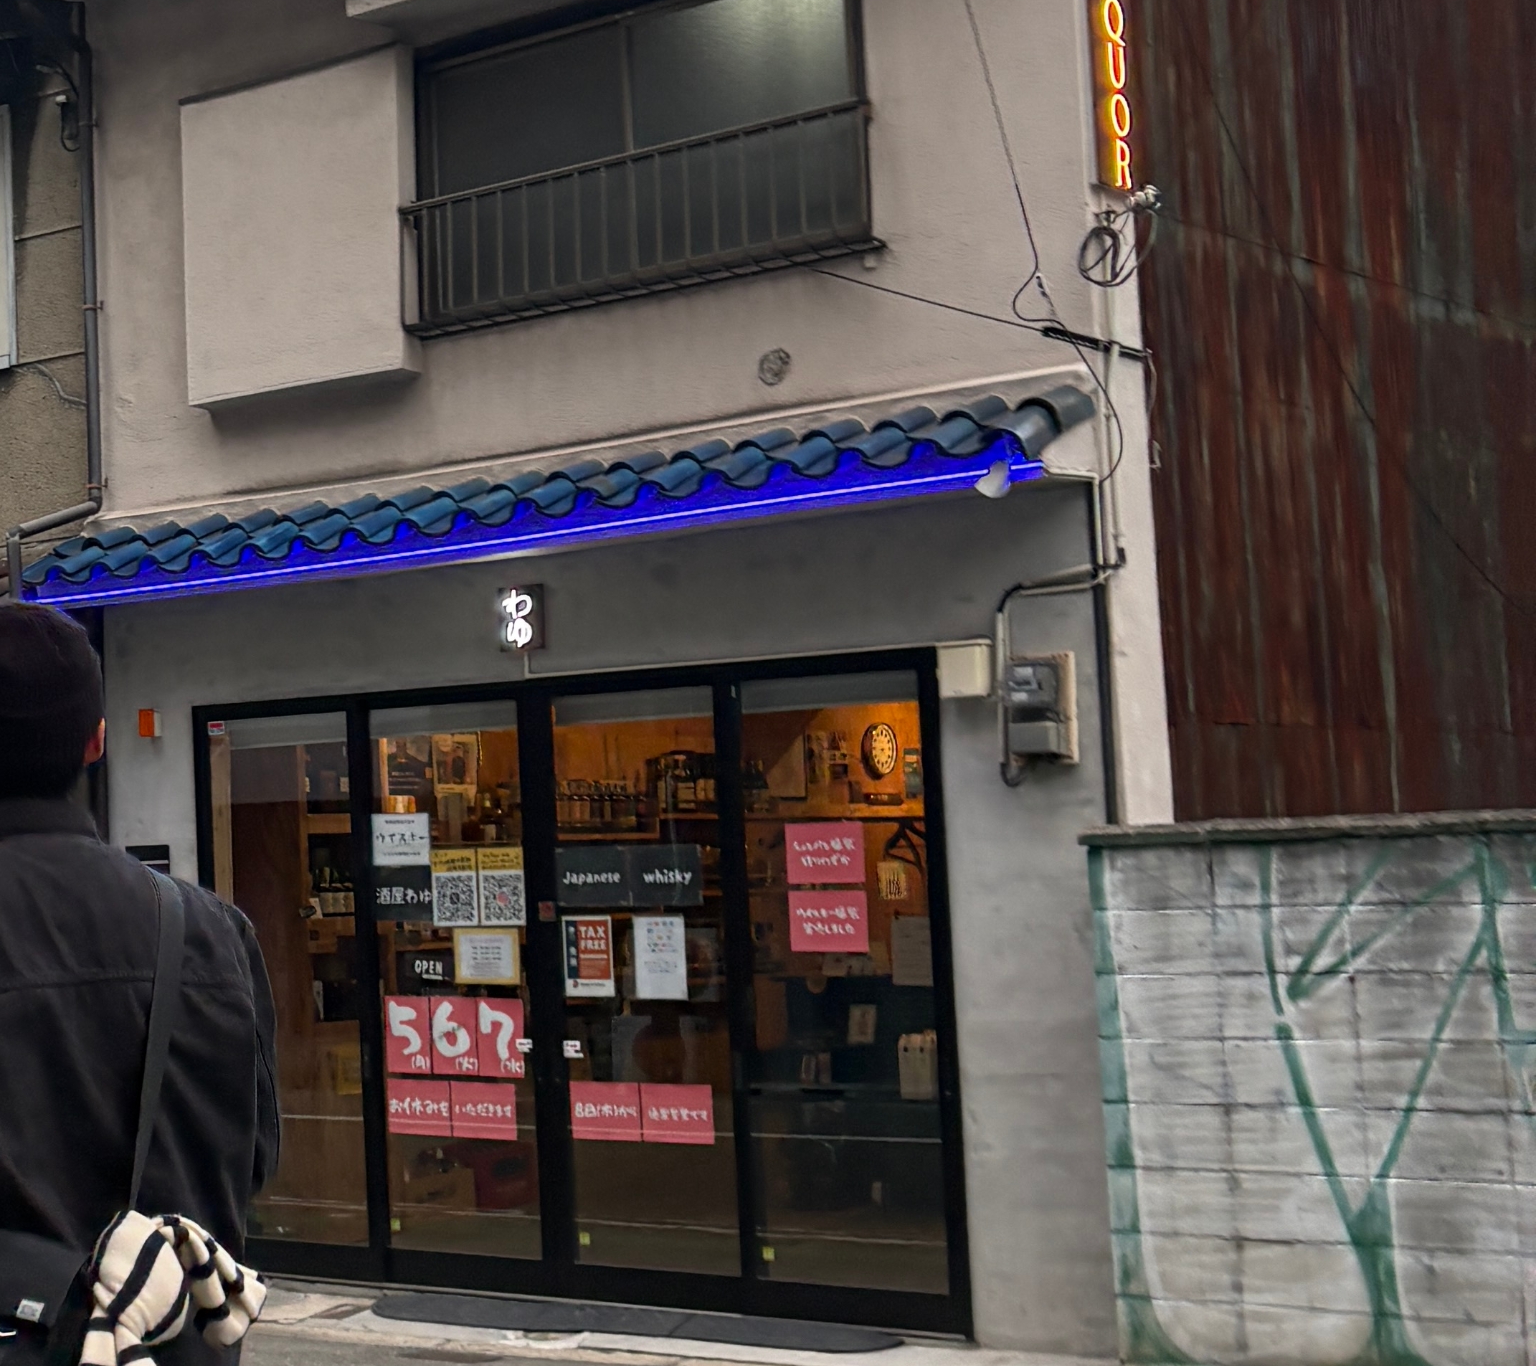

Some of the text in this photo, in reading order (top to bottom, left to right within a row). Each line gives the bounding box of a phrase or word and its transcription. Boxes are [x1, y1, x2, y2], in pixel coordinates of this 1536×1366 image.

[562, 868, 693, 885] Japanese whisky
[579, 925, 606, 939] TAX
[580, 939, 607, 951] FREE
[414, 959, 443, 975] OPEN
[388, 1000, 515, 1061] 5 6 7
